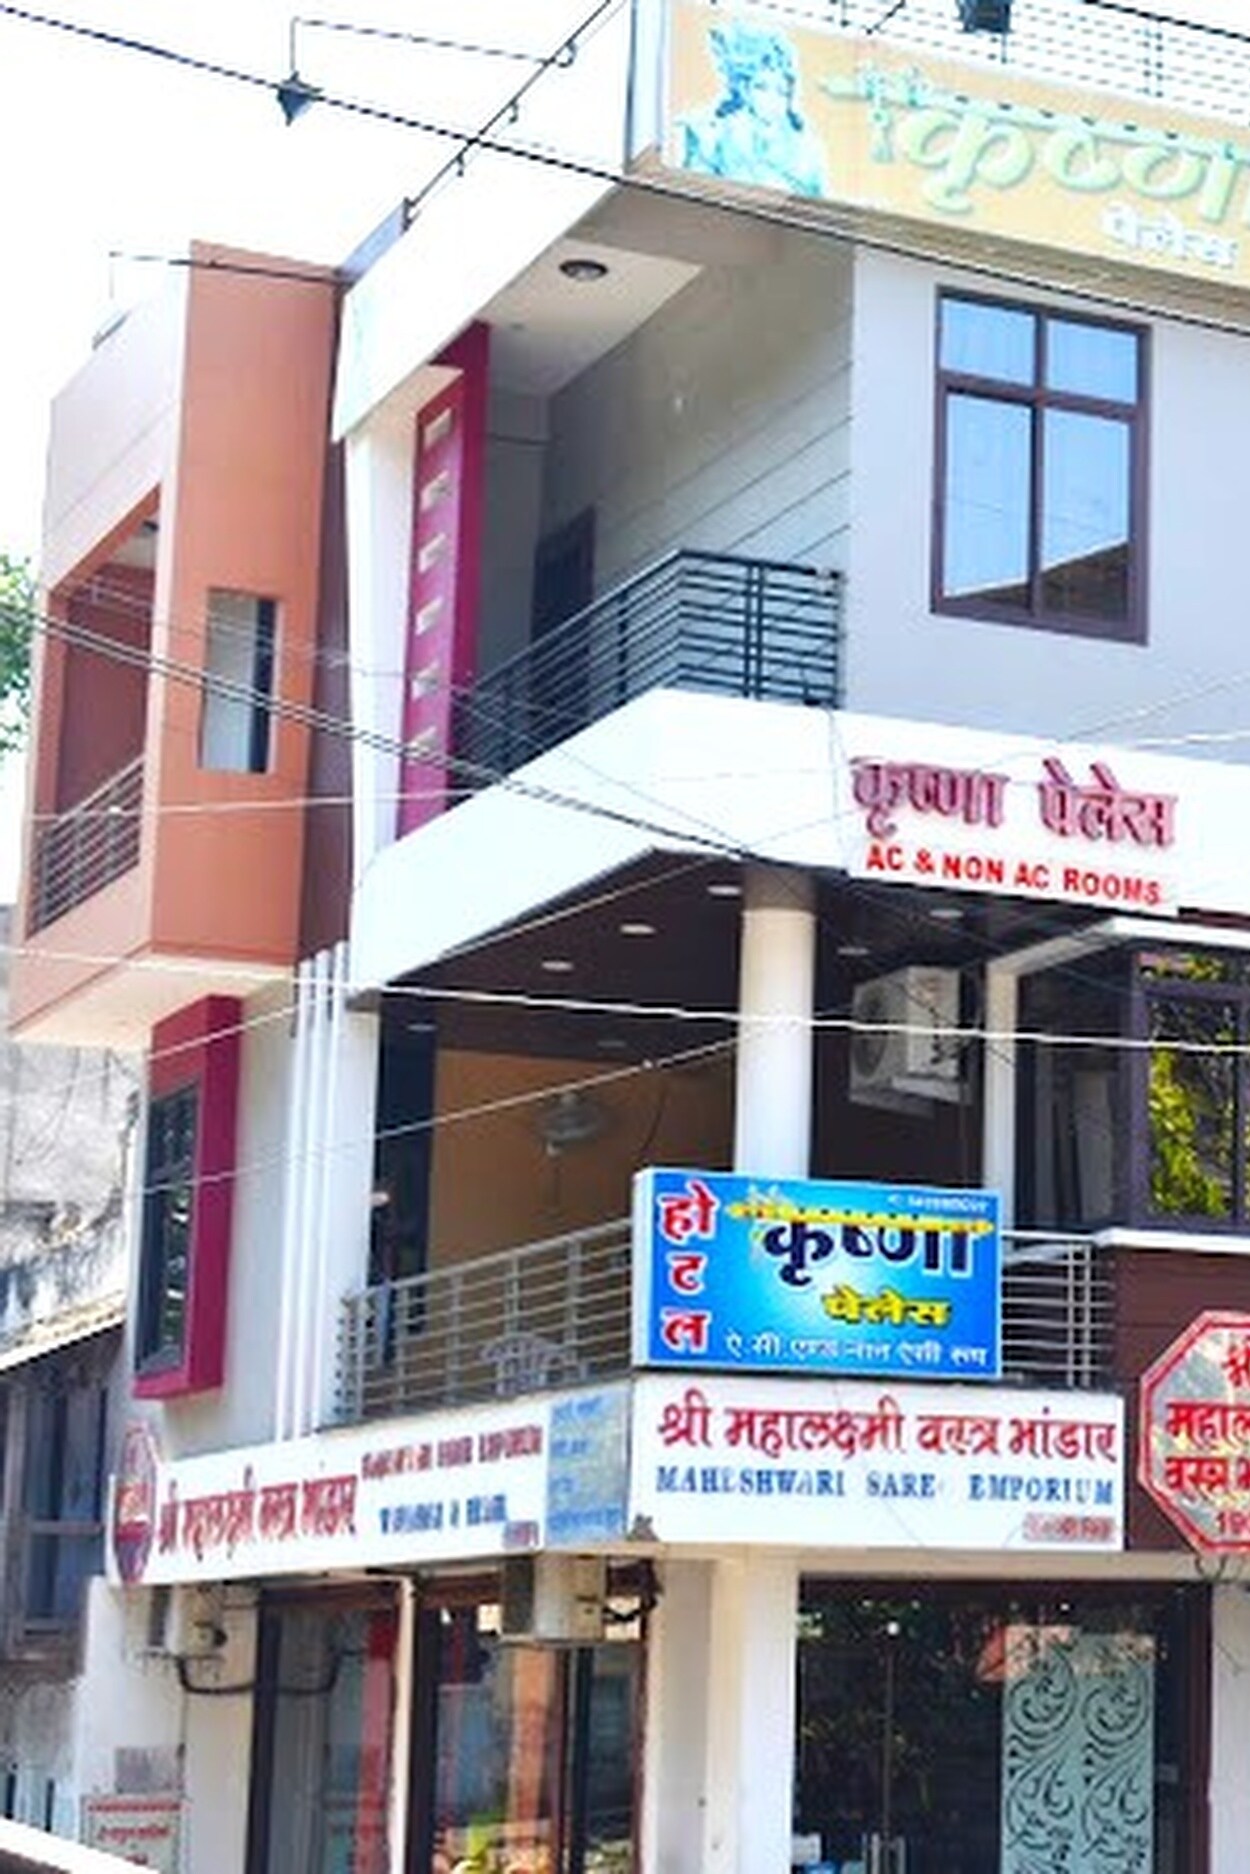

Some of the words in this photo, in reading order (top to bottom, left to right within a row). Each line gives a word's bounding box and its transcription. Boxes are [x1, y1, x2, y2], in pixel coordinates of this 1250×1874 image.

[849, 755, 1009, 839] कृष्णा
[866, 846, 903, 871] AC
[914, 850, 935, 873] &
[941, 855, 1003, 884] NON
[1014, 862, 1050, 889] AC
[1063, 869, 1163, 905] ROOMS
[738, 1200, 995, 1287] कृष्णा
[658, 1388, 712, 1447] श्री
[724, 1395, 904, 1458] महालक्ष्मी
[1009, 1406, 1117, 1463] भांडार
[969, 1474, 1113, 1504] EMPORIUM
